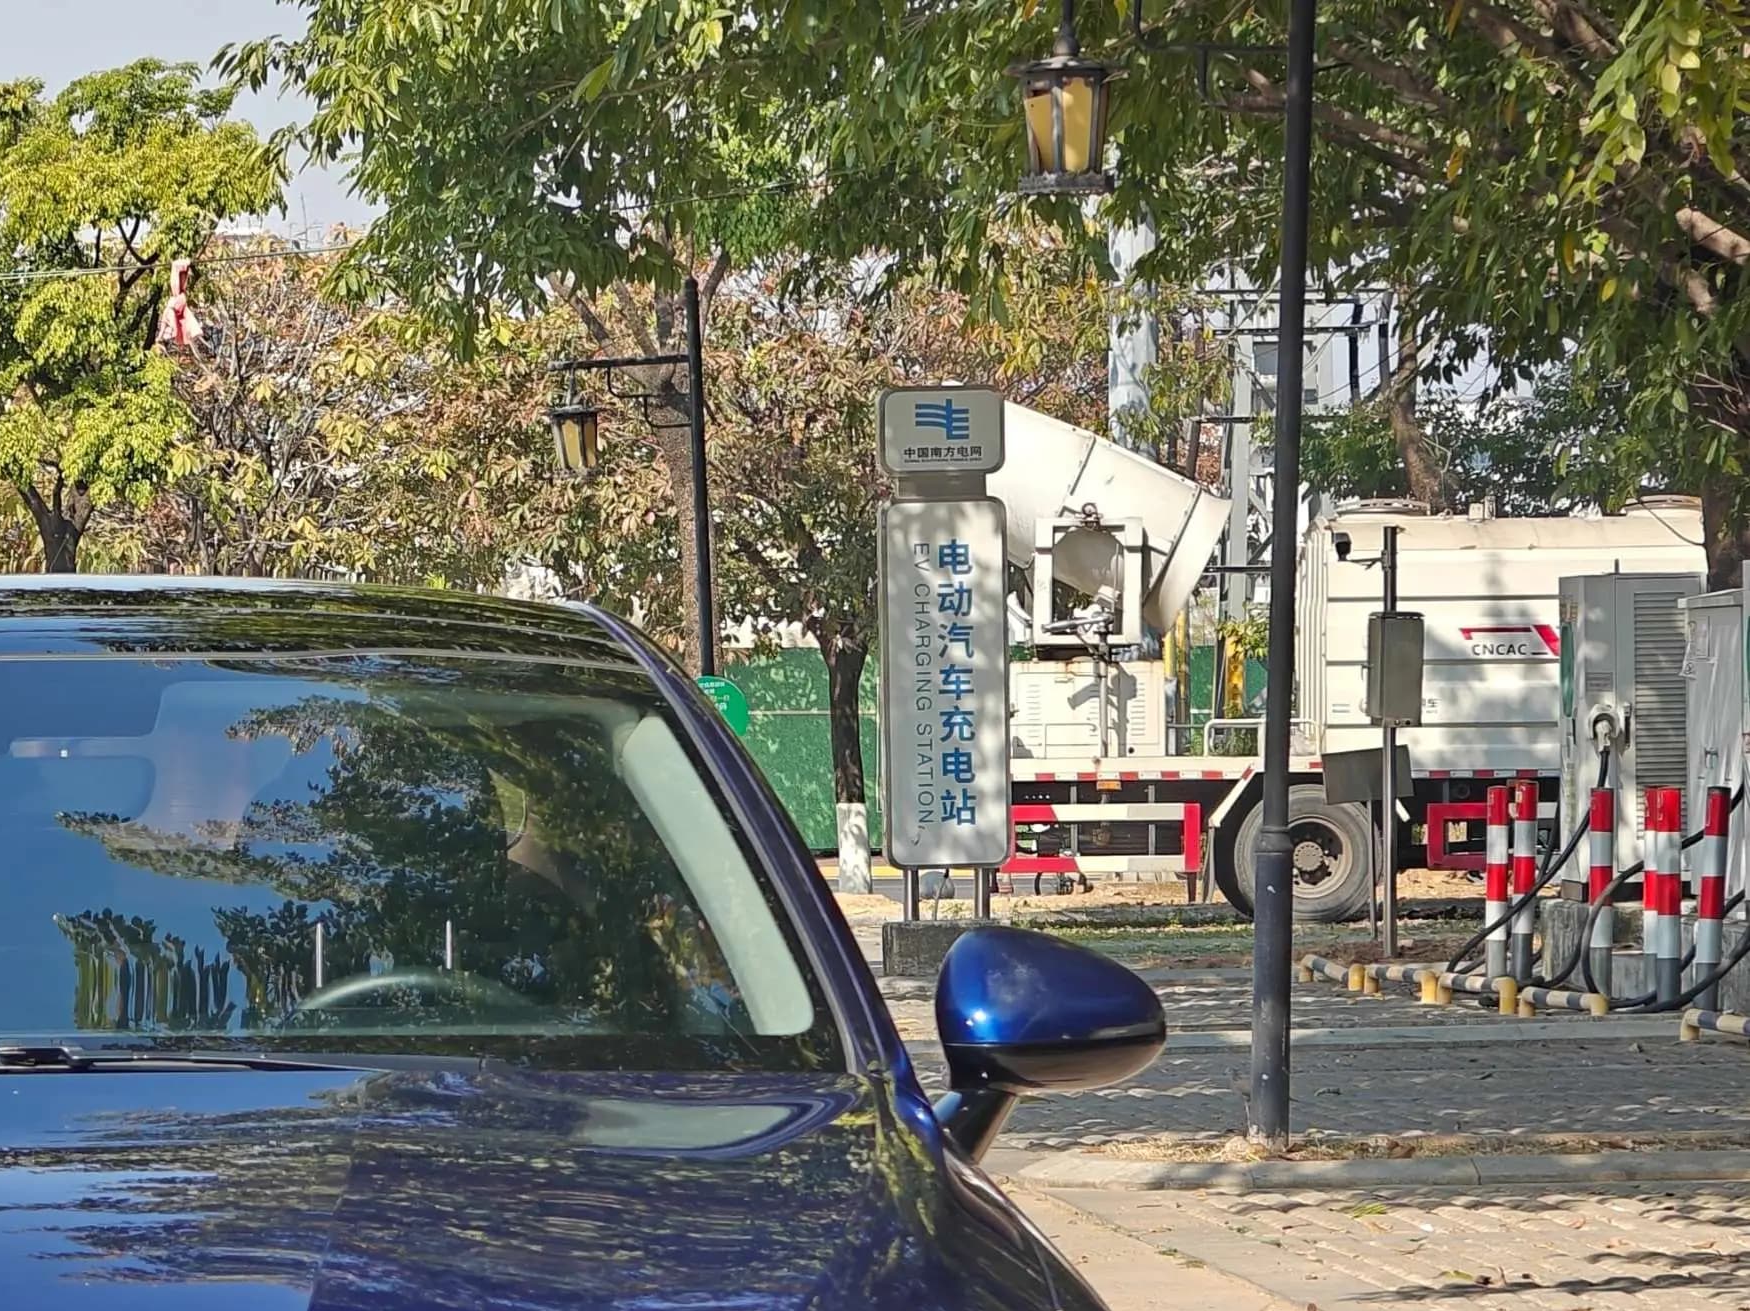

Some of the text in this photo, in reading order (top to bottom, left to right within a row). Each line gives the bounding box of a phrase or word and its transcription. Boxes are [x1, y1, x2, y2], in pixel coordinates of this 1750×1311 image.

[904, 446, 982, 458] 中国南方电网
[913, 543, 935, 824] EV CHARGING STATION
[937, 538, 977, 826] 电动汽车充电站
[1471, 643, 1528, 656] CNCAC
